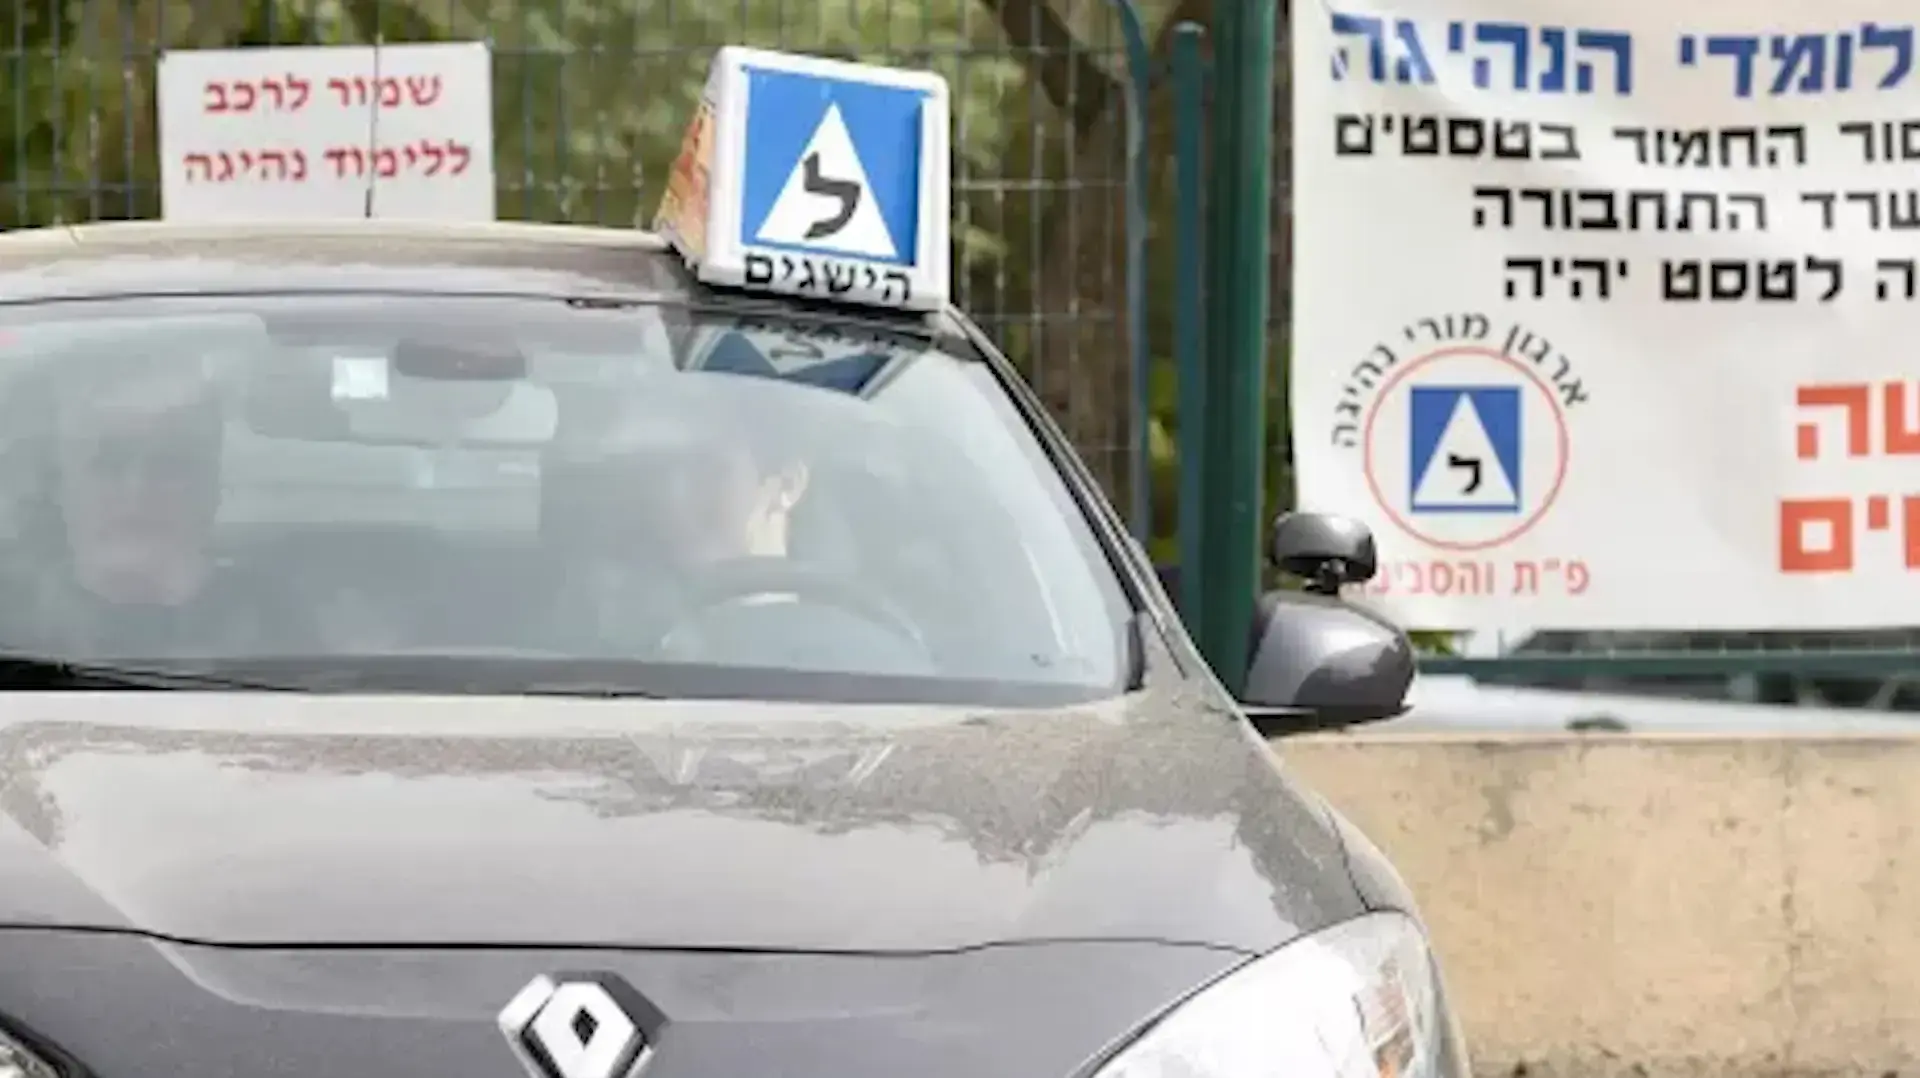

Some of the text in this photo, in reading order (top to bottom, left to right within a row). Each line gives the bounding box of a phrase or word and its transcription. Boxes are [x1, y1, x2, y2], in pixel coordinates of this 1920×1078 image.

[1331, 12, 1914, 98] לומדי הנהיגה
[204, 74, 440, 112] שמור לרכב
[1335, 114, 1581, 159] בטסטים
[1613, 124, 1806, 166] החמור
[184, 140, 470, 182] ללימוד נהיגה
[803, 151, 861, 239] ל
[1474, 187, 1766, 231] התחבורה
[744, 253, 910, 301] הישגים
[1505, 258, 1628, 299] יהיה
[1662, 255, 1842, 301] לטסט
[1331, 313, 1590, 448] ארגון מורי נהיגה
[1447, 452, 1482, 494] ל
[1780, 496, 1920, 571] ים
[1345, 559, 1590, 595] פ"ת והסביב
